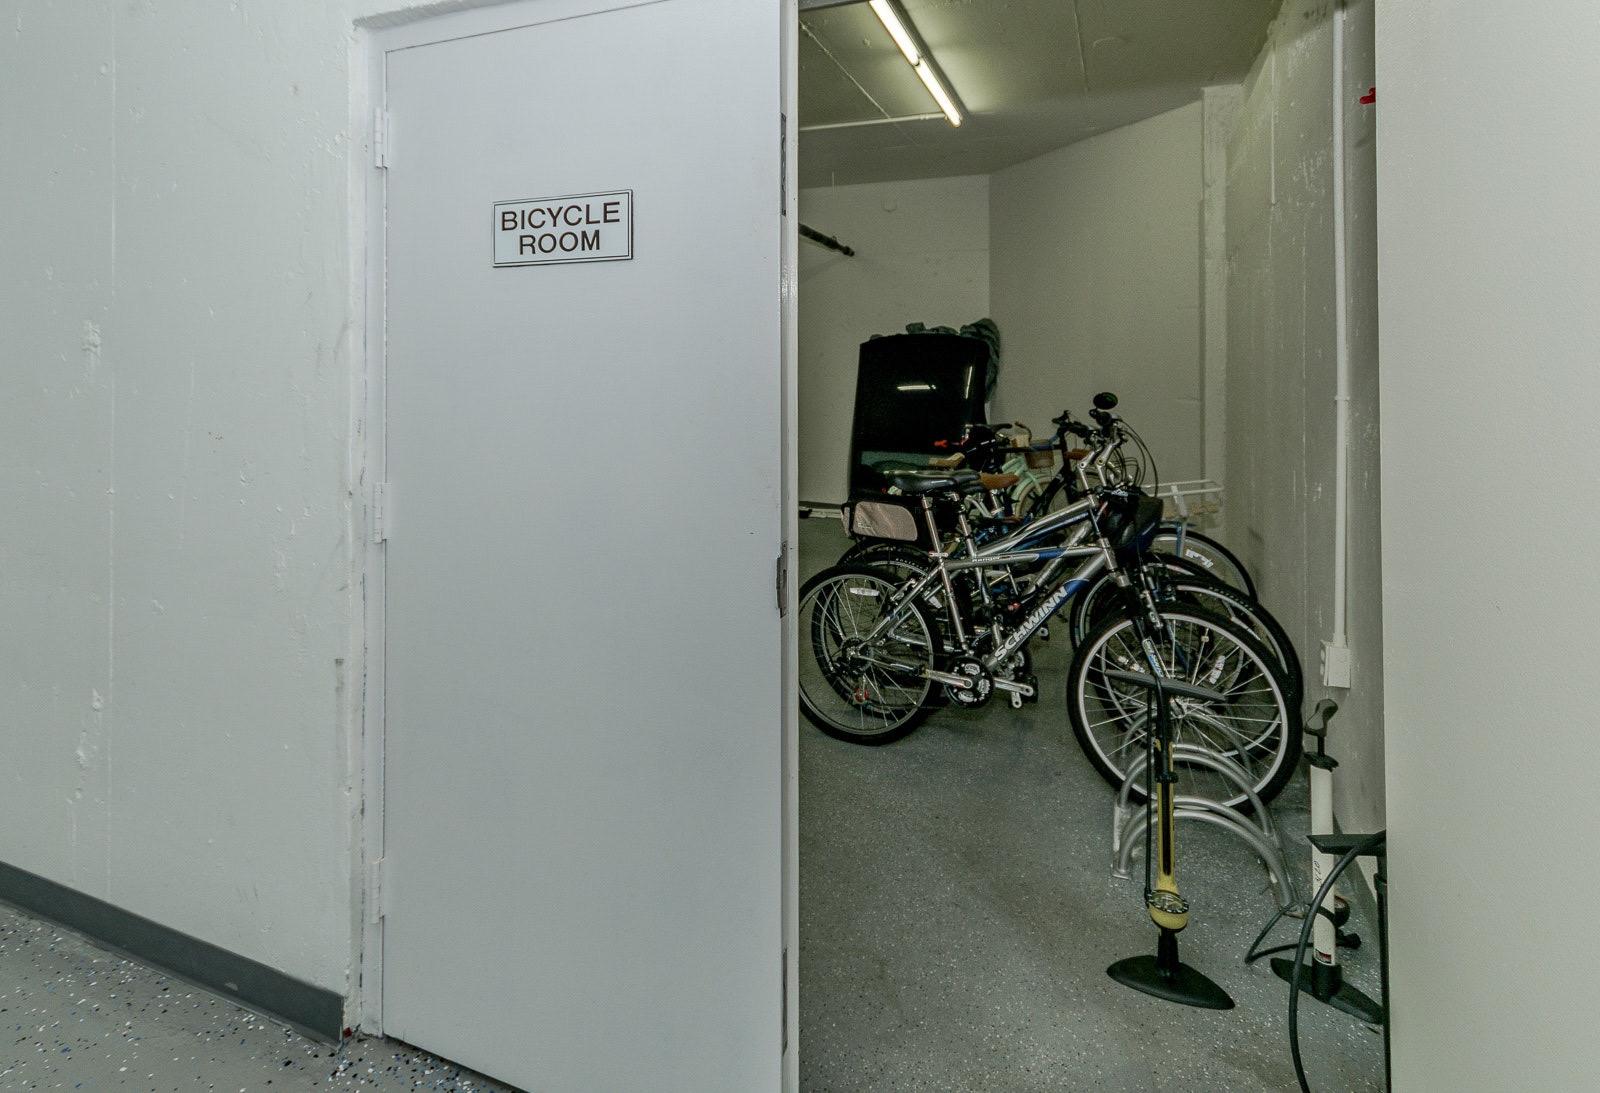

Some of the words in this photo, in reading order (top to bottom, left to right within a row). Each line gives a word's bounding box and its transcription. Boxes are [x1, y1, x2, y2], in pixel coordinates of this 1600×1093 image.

[501, 201, 620, 231] BICYCLE
[519, 229, 600, 255] ROOM
[994, 586, 1068, 661] SCHWINN
